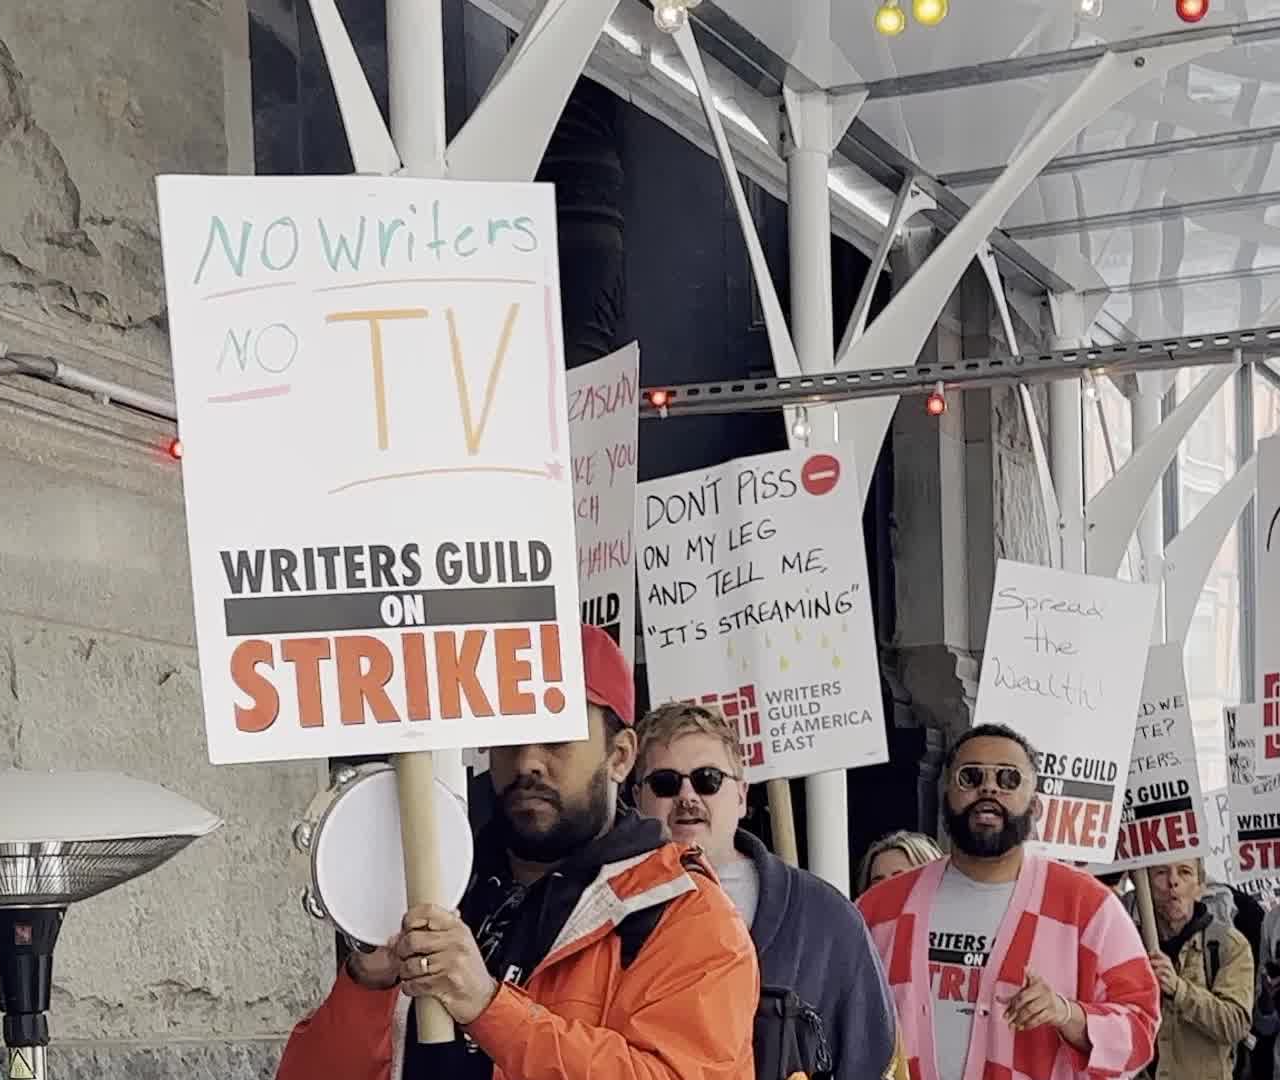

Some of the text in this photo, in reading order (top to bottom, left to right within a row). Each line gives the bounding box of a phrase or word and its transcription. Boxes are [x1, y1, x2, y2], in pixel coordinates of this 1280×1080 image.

[194, 214, 300, 285] NO
[216, 322, 299, 374] NO
[646, 468, 797, 530] DON'T PISS
[643, 519, 777, 570] ON MY LEG
[219, 539, 553, 595] WRITERS GUILD
[648, 581, 697, 606] AND
[705, 561, 765, 598] TELL
[379, 594, 424, 626] ON
[995, 587, 1103, 621] Spread
[229, 624, 568, 733] STRIKE!
[765, 681, 841, 705] WRITERS
[768, 701, 821, 721] GUILD
[1160, 695, 1184, 711] WE
[770, 709, 873, 737] of AMERICA
[772, 734, 816, 754] EAST
[1071, 757, 1118, 782] GUILD
[1043, 778, 1065, 795] ON
[1137, 779, 1190, 803] GUILD
[963, 952, 984, 966] ON
